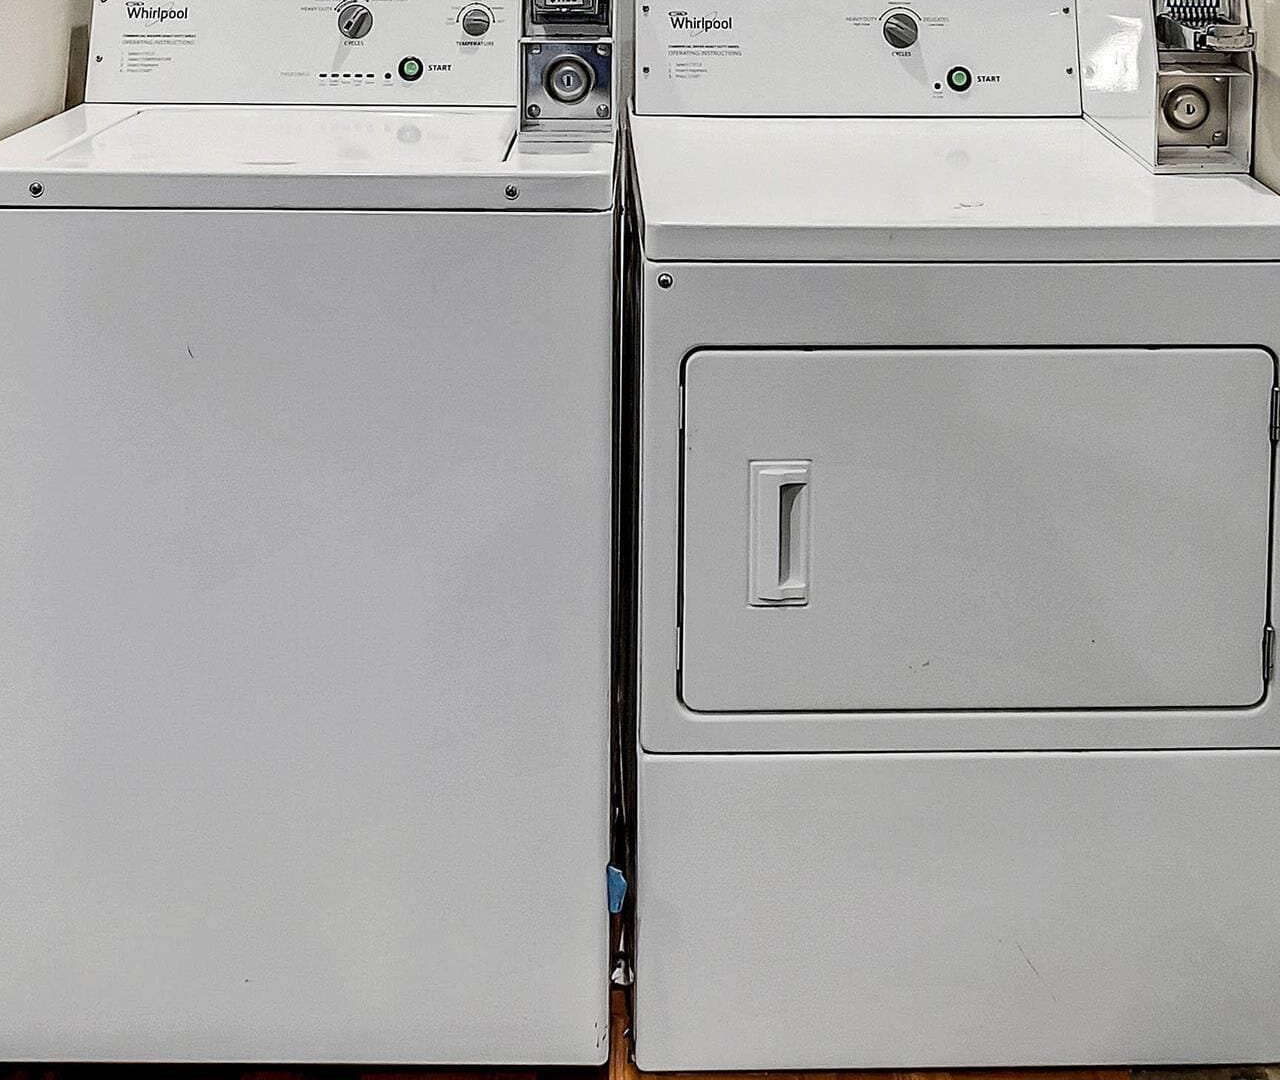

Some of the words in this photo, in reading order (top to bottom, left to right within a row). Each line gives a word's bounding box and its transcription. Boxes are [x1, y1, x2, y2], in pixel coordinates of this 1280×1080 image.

[126, 6, 189, 23] Whirlpool
[670, 16, 733, 32] Whirlpool
[892, 50, 912, 58] CYCLES
[427, 63, 453, 72] START
[976, 74, 1002, 84] START
